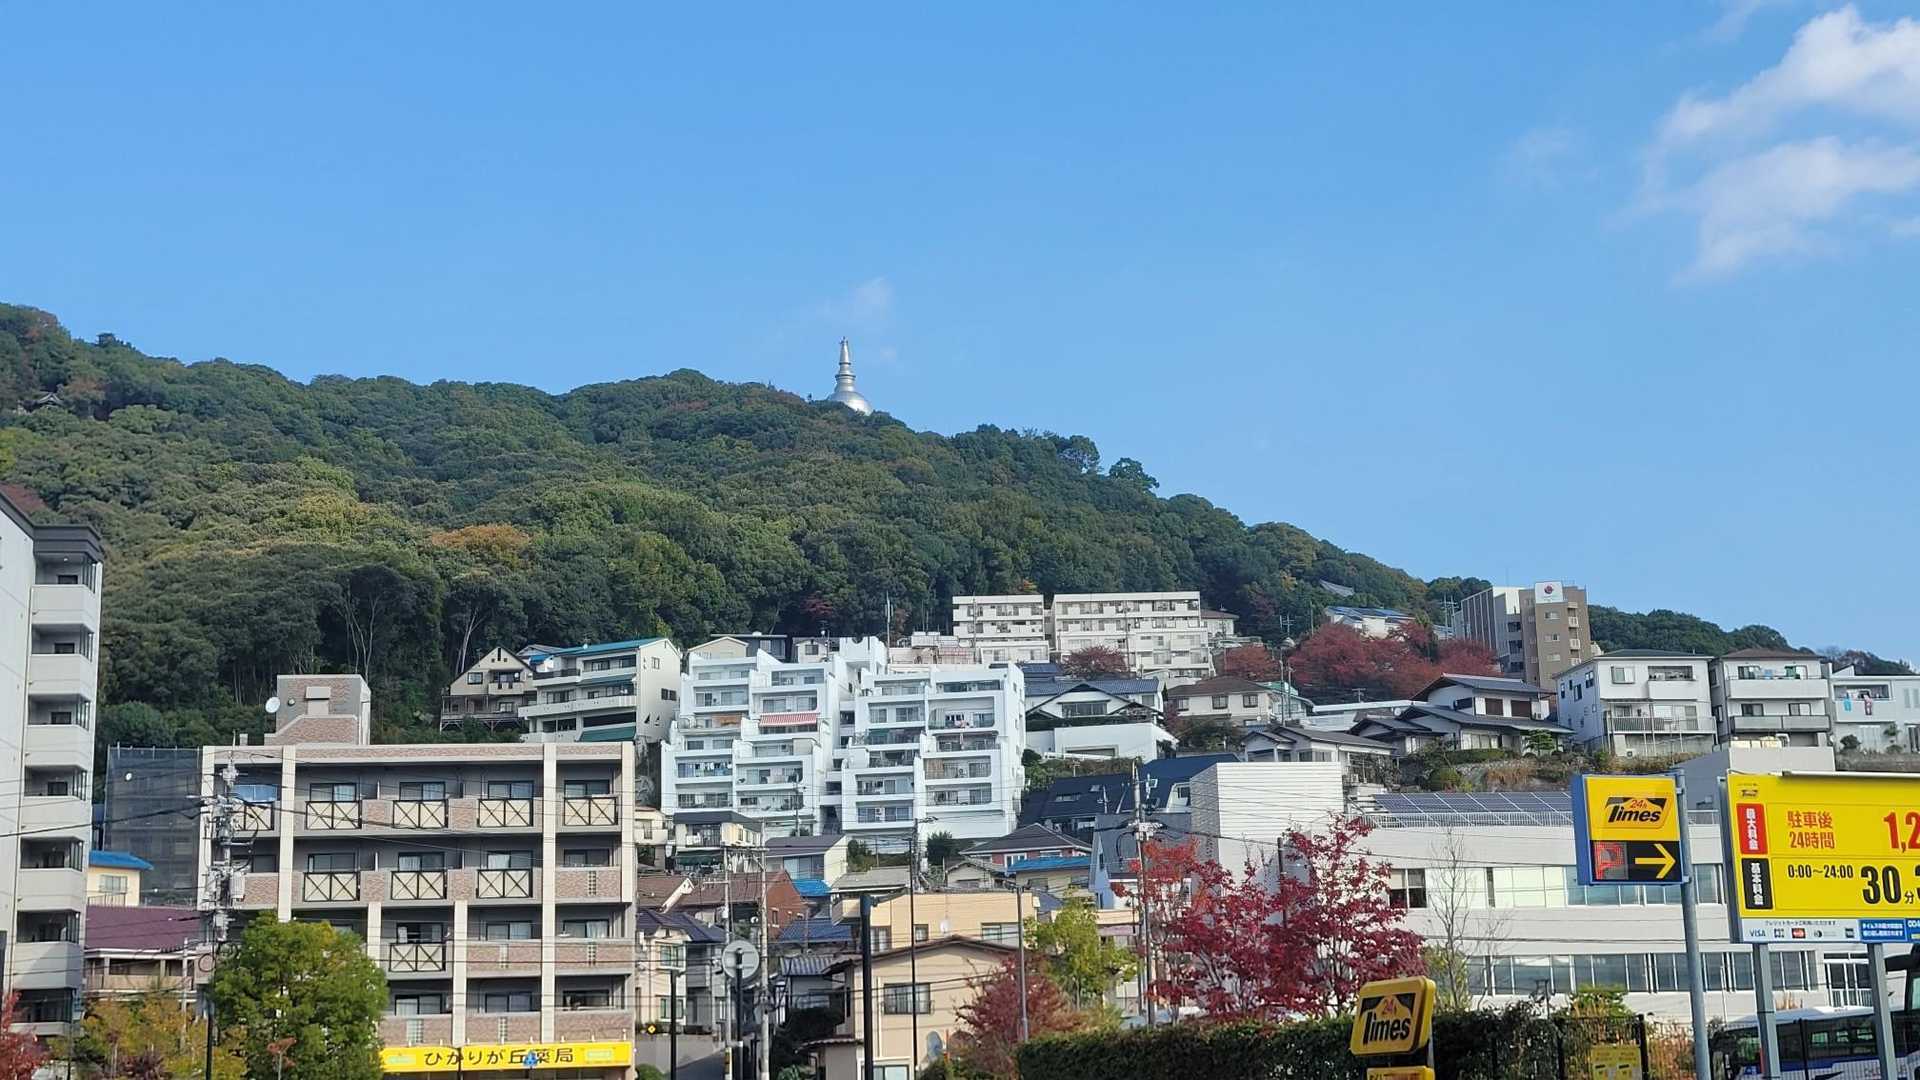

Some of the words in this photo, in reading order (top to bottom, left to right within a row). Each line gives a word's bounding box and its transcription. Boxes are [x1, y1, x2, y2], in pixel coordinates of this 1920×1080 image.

[1608, 805, 1662, 823] Times
[1787, 810, 1833, 829] 駐車後
[1789, 831, 1835, 849] 24時間
[1362, 1010, 1412, 1045] Times
[424, 1047, 573, 1066] ひかりが丘薬局
